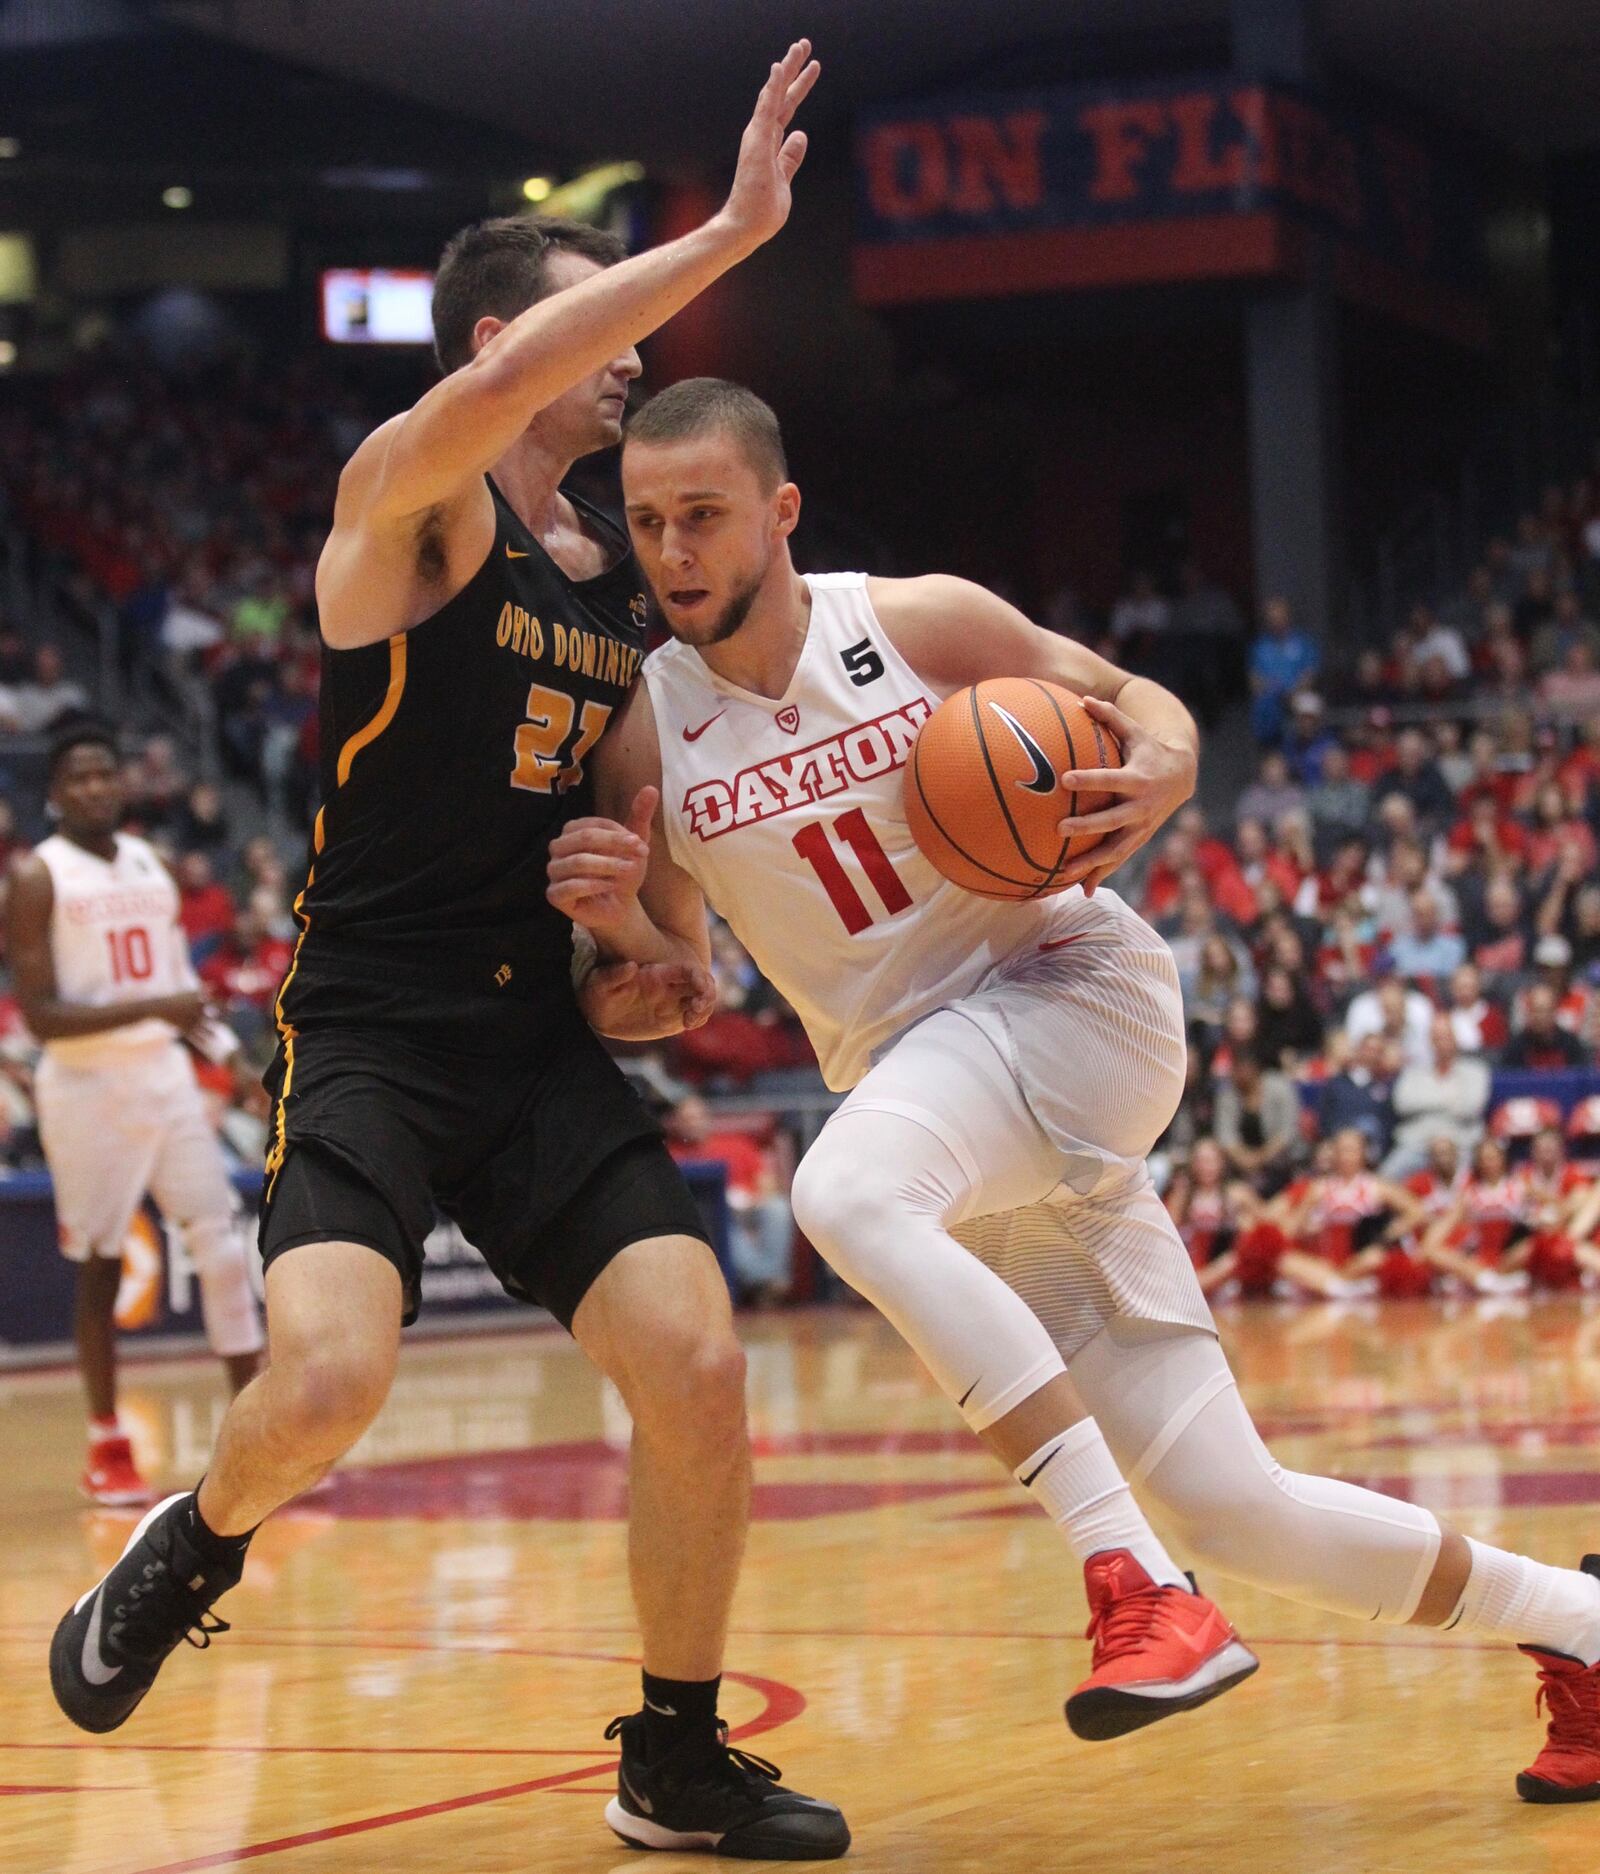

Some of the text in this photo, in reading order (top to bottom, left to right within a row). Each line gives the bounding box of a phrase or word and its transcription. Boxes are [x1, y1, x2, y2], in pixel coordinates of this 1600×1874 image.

[866, 107, 1046, 221] ON
[496, 601, 545, 660] OHIO
[839, 637, 885, 687] 5
[510, 683, 613, 794] 21
[682, 697, 934, 842] DAYTON
[791, 806, 914, 936] 11
[106, 927, 153, 984] 10
